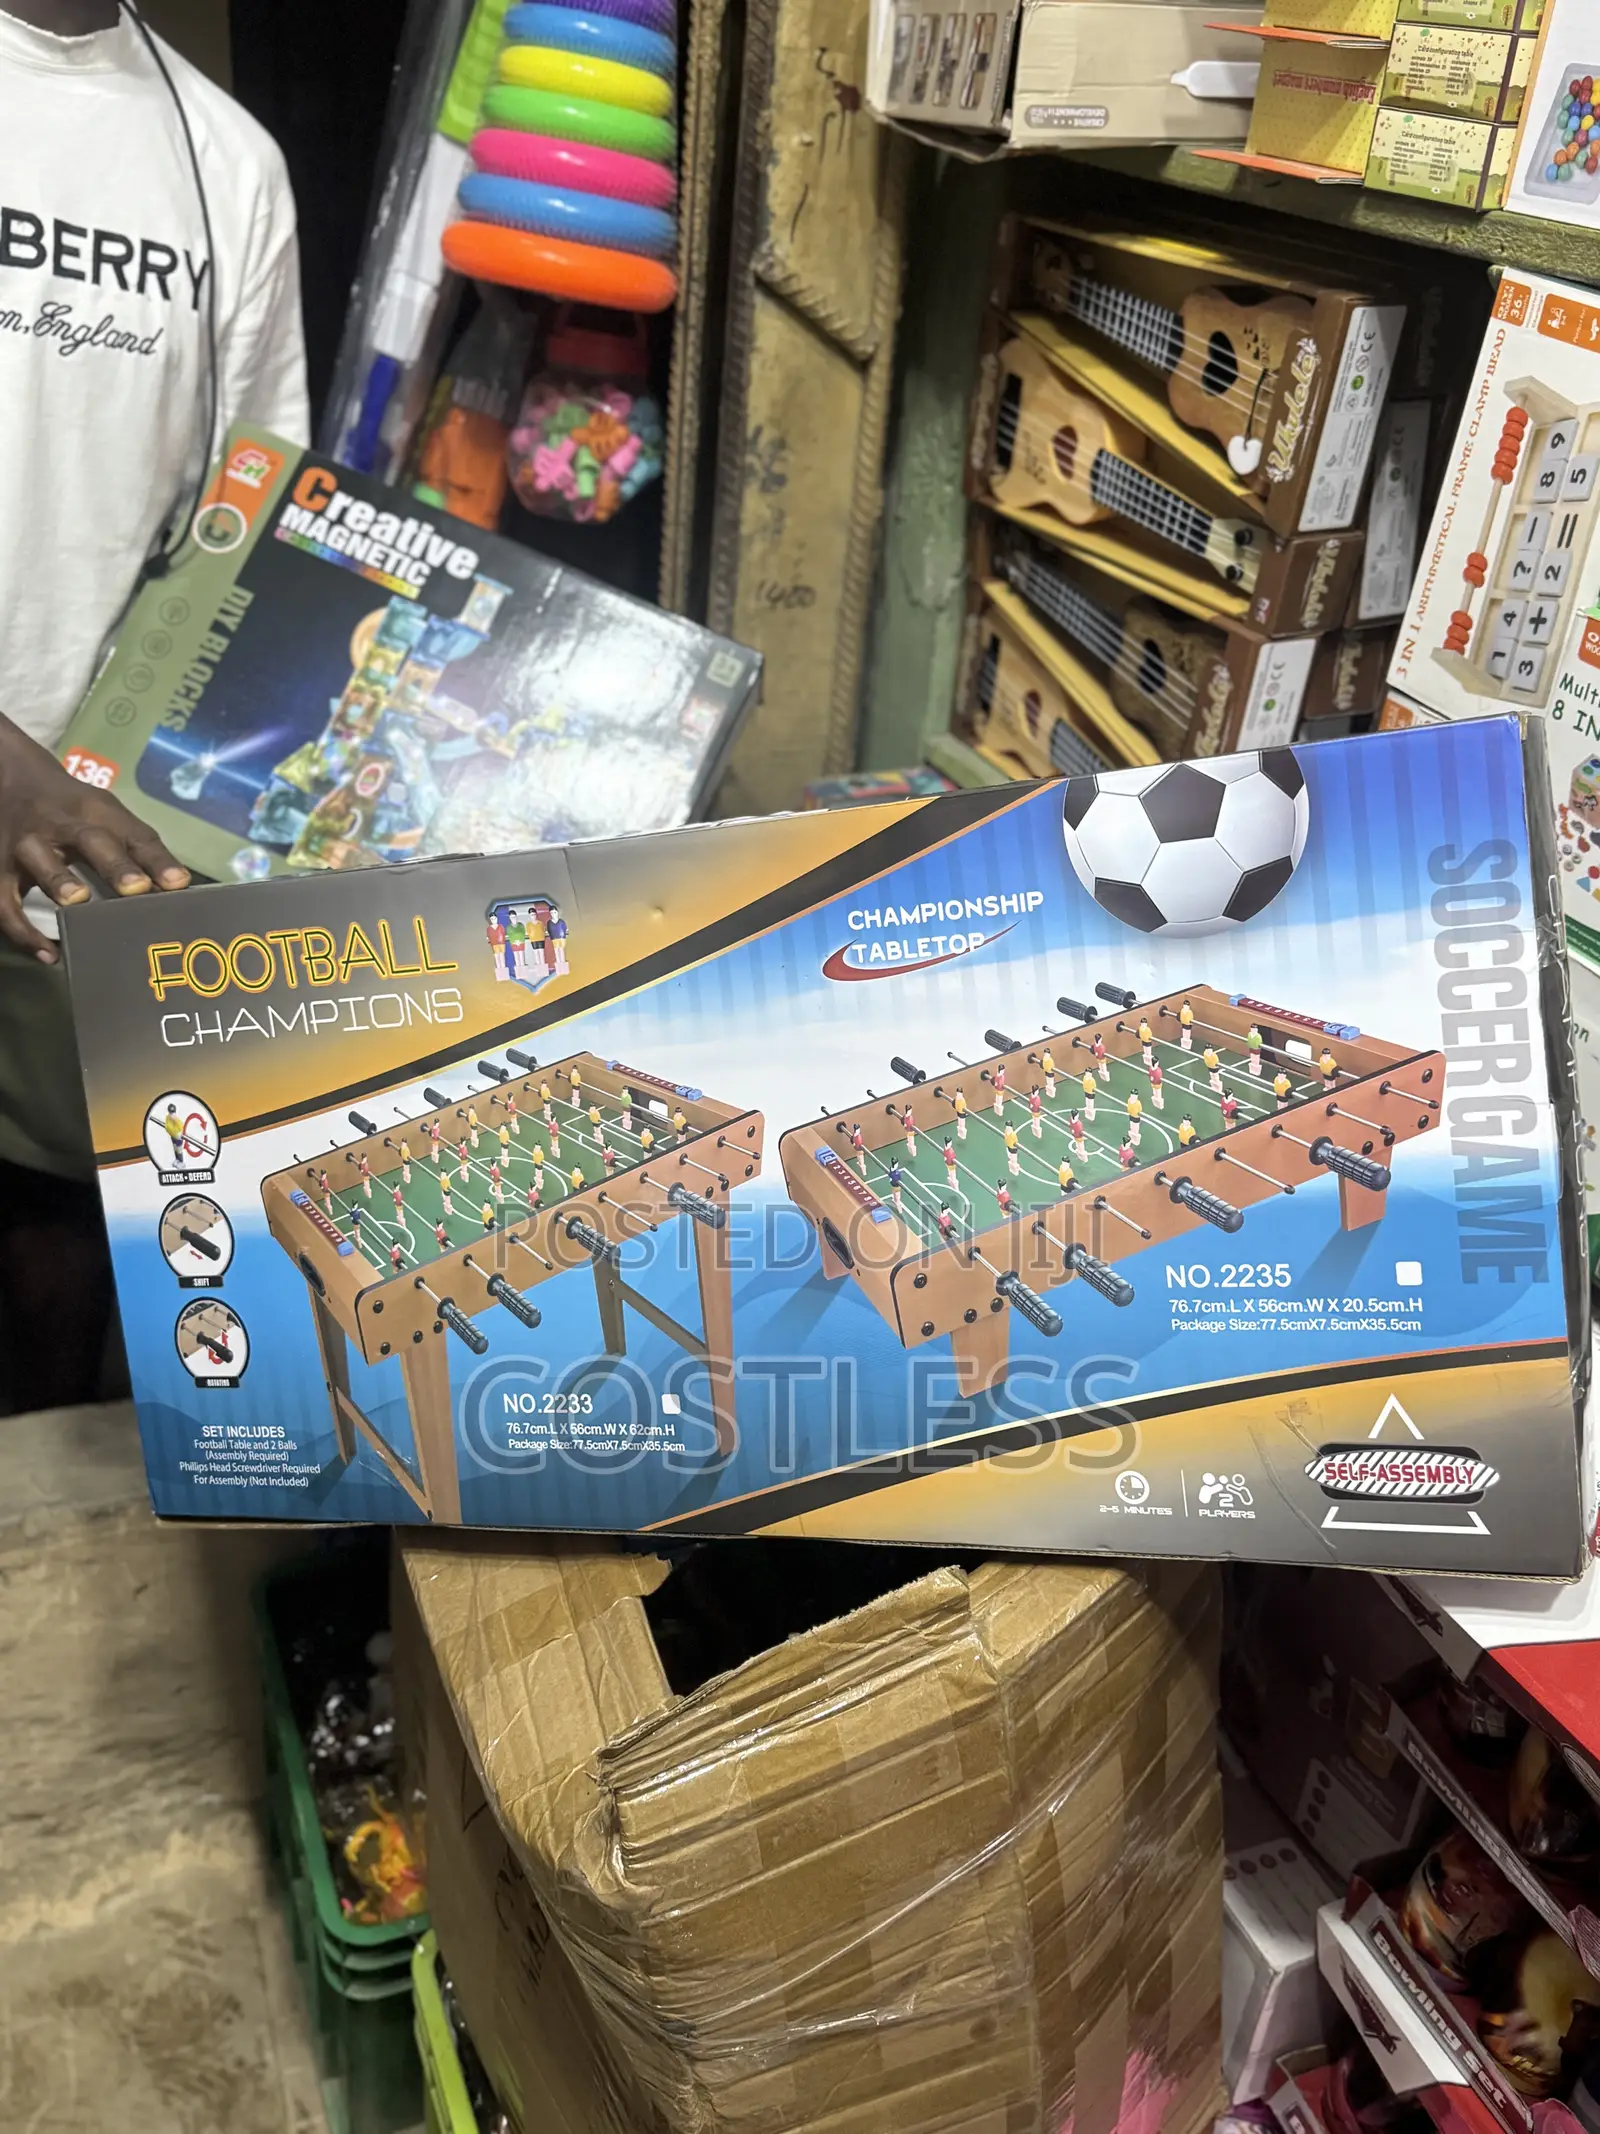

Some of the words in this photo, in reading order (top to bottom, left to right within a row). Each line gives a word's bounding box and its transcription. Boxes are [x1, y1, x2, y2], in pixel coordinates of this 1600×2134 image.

[0, 206, 209, 311] BERRY
[32, 301, 165, 357] England
[1401, 638, 1416, 663] IN
[1452, 440, 1474, 497] FRAME
[1468, 379, 1491, 438] CLAMP
[1486, 328, 1507, 377] BEAD
[292, 466, 480, 580] Creative
[1502, 610, 1518, 627] 4
[1539, 470, 1556, 488] 8
[1551, 432, 1566, 449] 9
[278, 503, 431, 587] MAGNETIC
[1518, 659, 1534, 677] 3
[1544, 564, 1562, 581] 2
[1569, 468, 1587, 485] 5
[1551, 699, 1565, 721] 8
[847, 890, 1044, 931] CHAMPIONSHIP
[148, 913, 459, 1002] FOOTBALL
[851, 932, 986, 964] TABLETOP
[1426, 839, 1534, 1088] SOCCER
[160, 986, 464, 1048] CHAMPIONS
[161, 1173, 185, 1184] ATTACK
[1446, 1094, 1551, 1286] GAME
[192, 1277, 210, 1288] SHIFT
[1165, 1262, 1292, 1289] NO.2235
[1168, 1299, 1242, 1314] 76.7cm.L
[1243, 1299, 1256, 1313] X
[1258, 1298, 1325, 1314] 56cm.W
[1327, 1298, 1340, 1313] X
[1342, 1297, 1423, 1313] 20.5cm.H
[1171, 1318, 1226, 1334] Package
[502, 1393, 594, 1414] NO.2233
[202, 1425, 224, 1438] SET
[227, 1425, 286, 1439] INCLUDES
[506, 1422, 558, 1436] 76.7cm.L
[618, 1423, 628, 1436] X
[629, 1423, 676, 1437] 62cm.H
[193, 1439, 228, 1450] Football
[228, 1439, 252, 1450] Table
[253, 1440, 269, 1450] and
[270, 1440, 277, 1450] 2
[278, 1440, 298, 1451] Balls
[205, 1450, 248, 1463] (Assembly
[249, 1450, 289, 1463] Required)
[508, 1438, 549, 1452] Package
[179, 1461, 208, 1474] Phillips
[209, 1462, 231, 1472] Head
[231, 1463, 281, 1473] Screwdriver
[282, 1463, 321, 1475] Required
[1323, 1462, 1476, 1486] SELF-ASSEMBLY
[193, 1474, 208, 1485] For
[209, 1475, 248, 1488] Assembly
[249, 1476, 268, 1487] (Not
[268, 1476, 309, 1488] Included)
[1123, 1505, 1173, 1516] MINUTES
[1198, 1508, 1256, 1519] PLAYERS
[1373, 1930, 1463, 2053] Bowling
[1462, 2050, 1508, 2110] Set
